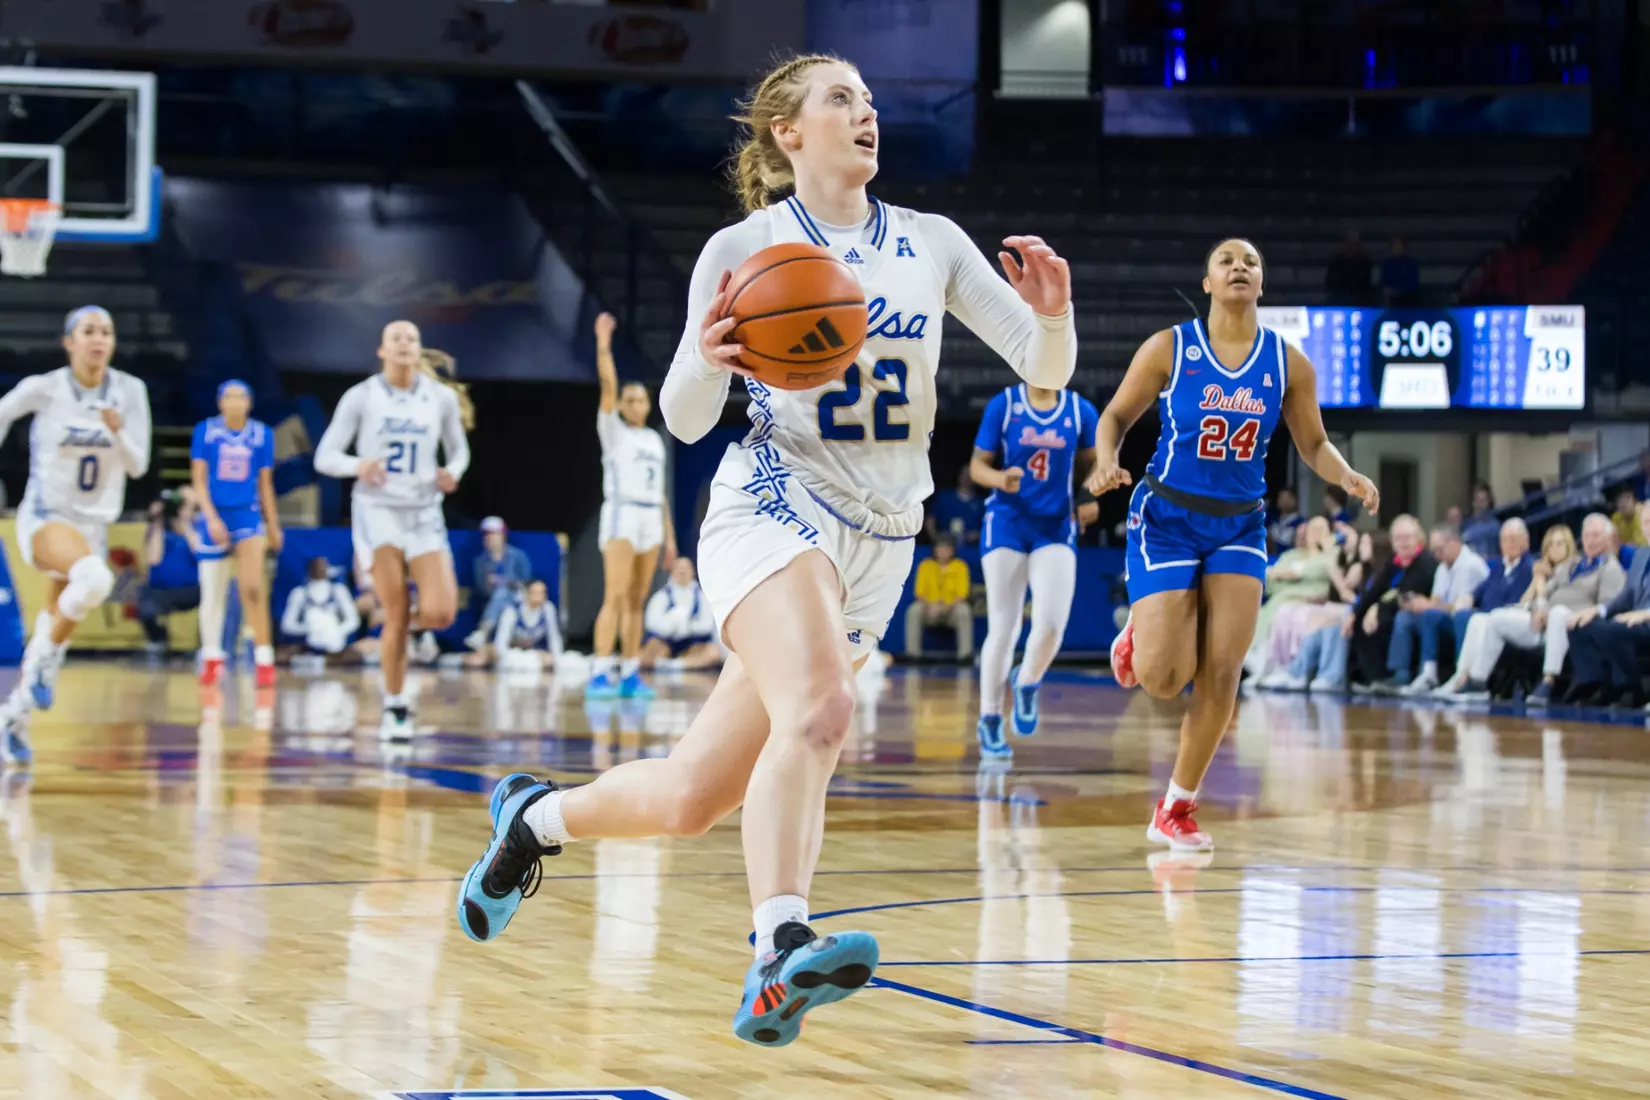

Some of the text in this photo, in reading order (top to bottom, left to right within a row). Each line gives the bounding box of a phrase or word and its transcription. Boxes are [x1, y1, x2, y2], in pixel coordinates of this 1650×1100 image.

[866, 296, 929, 341] lsa
[1378, 320, 1453, 358] 5:06
[1537, 346, 1572, 373] 39
[817, 358, 910, 441] 22
[1199, 384, 1266, 415] Dallas
[385, 440, 418, 474] 21
[1197, 415, 1260, 461] 24
[78, 453, 98, 492] 0
[1026, 447, 1051, 482] 4
